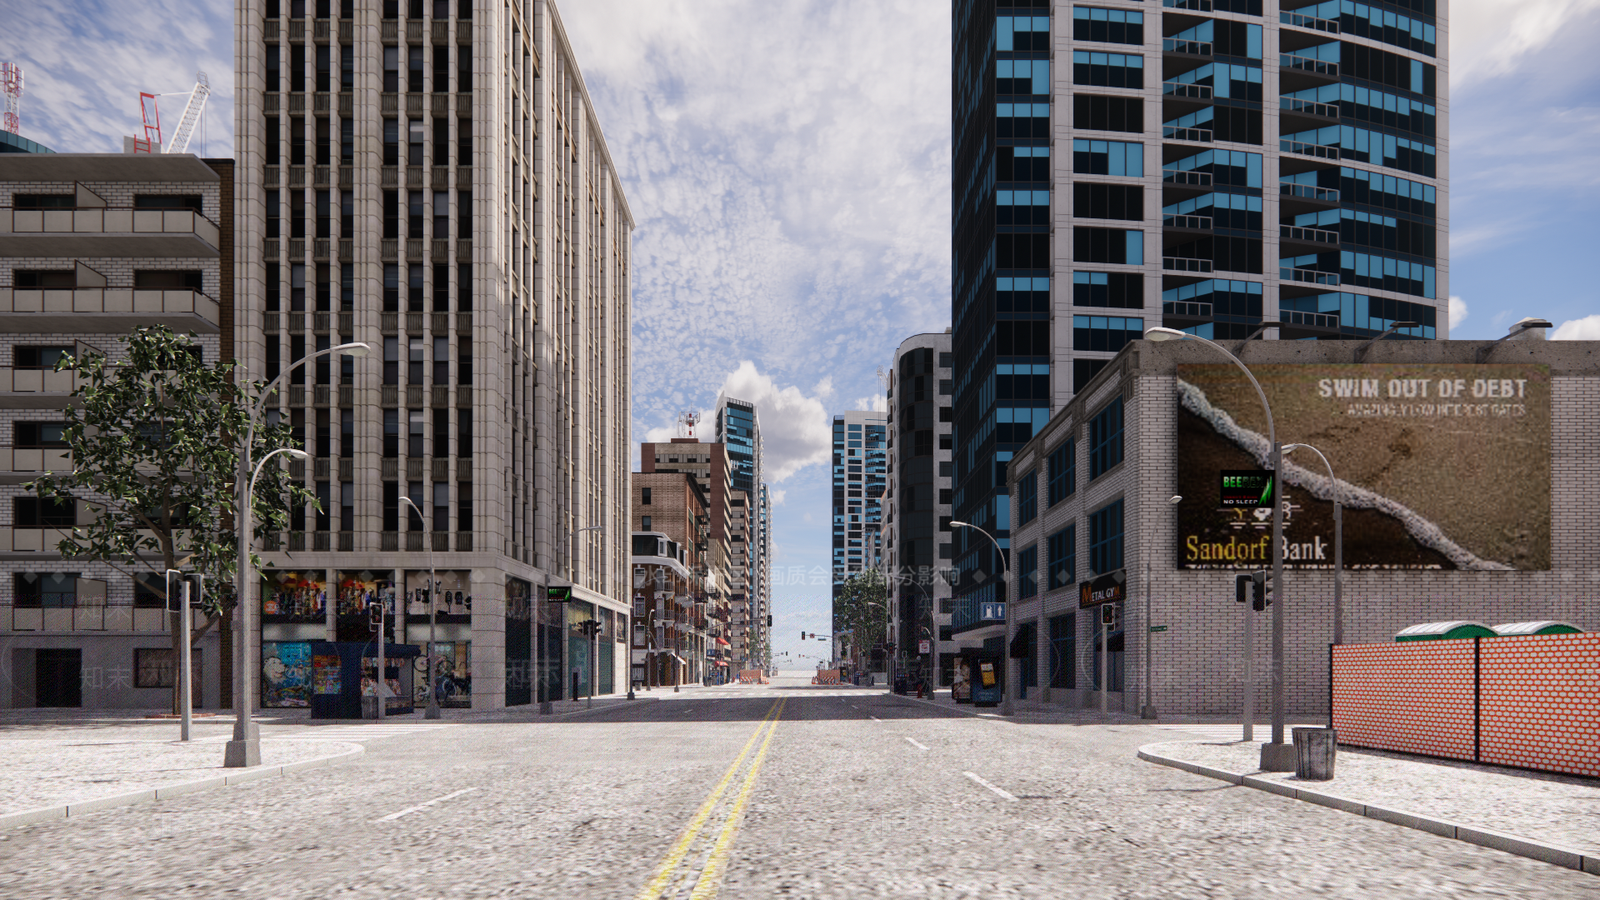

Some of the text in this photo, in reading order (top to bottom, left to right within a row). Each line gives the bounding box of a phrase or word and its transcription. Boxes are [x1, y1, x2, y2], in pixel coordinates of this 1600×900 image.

[1318, 378, 1528, 398] SWIM OUT OF DEBT
[1186, 535, 1270, 561] Sandorf
[1082, 585, 1120, 603] METAL GYM
